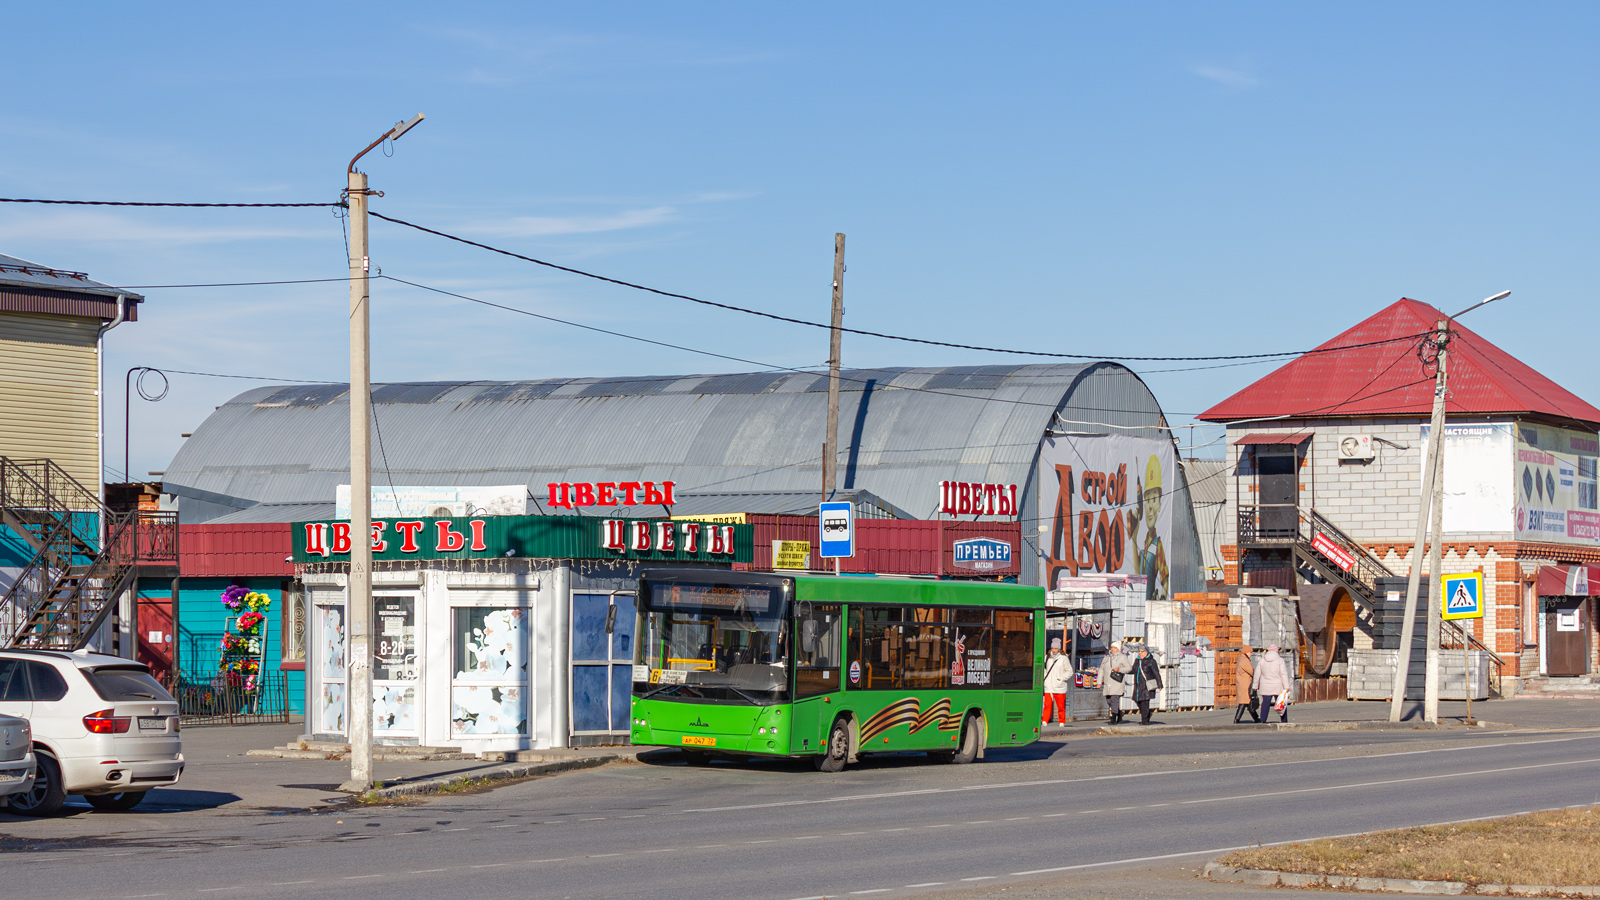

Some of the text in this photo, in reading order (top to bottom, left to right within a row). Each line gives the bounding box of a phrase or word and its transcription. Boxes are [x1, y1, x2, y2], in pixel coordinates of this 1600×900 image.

[1444, 427, 1493, 436] НАСТОЯЩИЕ
[1081, 463, 1128, 507] СТРОЙ
[547, 481, 677, 510] ЦВЕТЫ
[938, 480, 1018, 518] ЦВЕТЫ
[304, 520, 487, 557] ЦВЕТЫ
[602, 519, 735, 554] ЦВЕТЫ
[956, 544, 1009, 560] ПРЕМЬЕР
[975, 561, 994, 569] МАГАЗИН
[380, 641, 405, 656] 8-20
[967, 657, 991, 671] ВЕЛИКОЙ
[652, 671, 659, 682] 6
